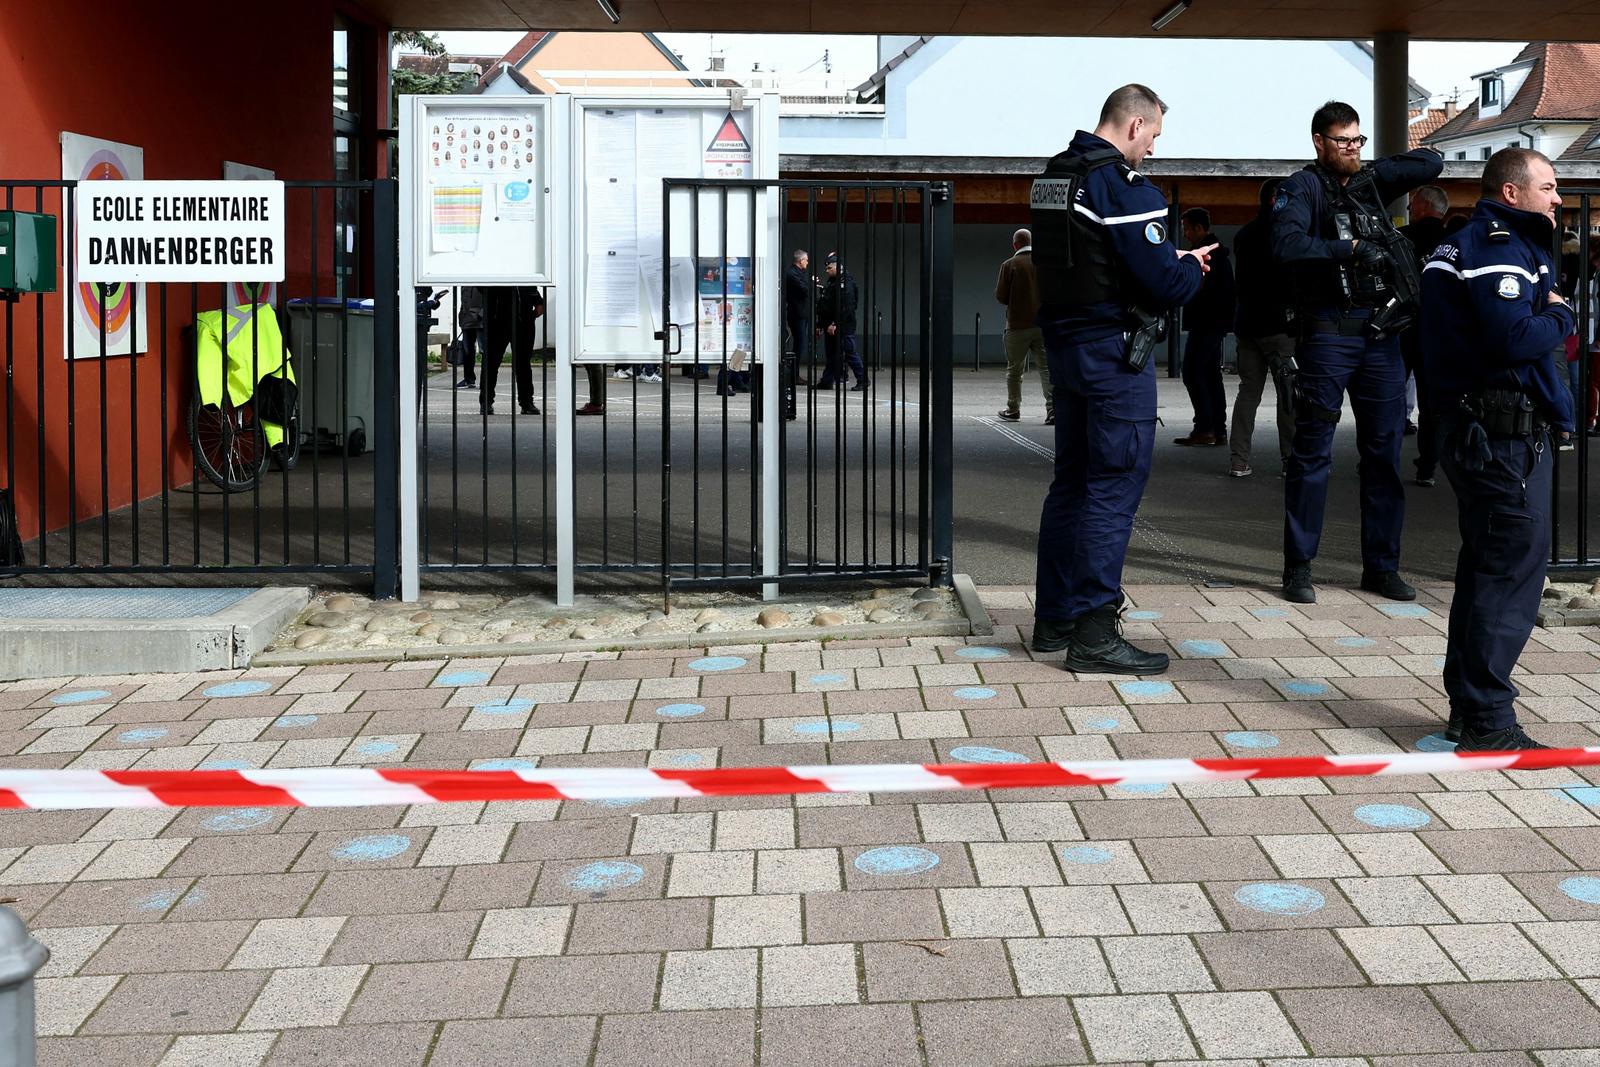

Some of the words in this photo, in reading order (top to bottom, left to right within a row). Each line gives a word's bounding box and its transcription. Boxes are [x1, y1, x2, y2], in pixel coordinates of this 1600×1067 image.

[1032, 183, 1069, 204] GENDARMERIE
[93, 196, 144, 221] ECOLE
[153, 197, 269, 221] ELEMENTAIRE
[89, 237, 273, 265] DANNENBERGER
